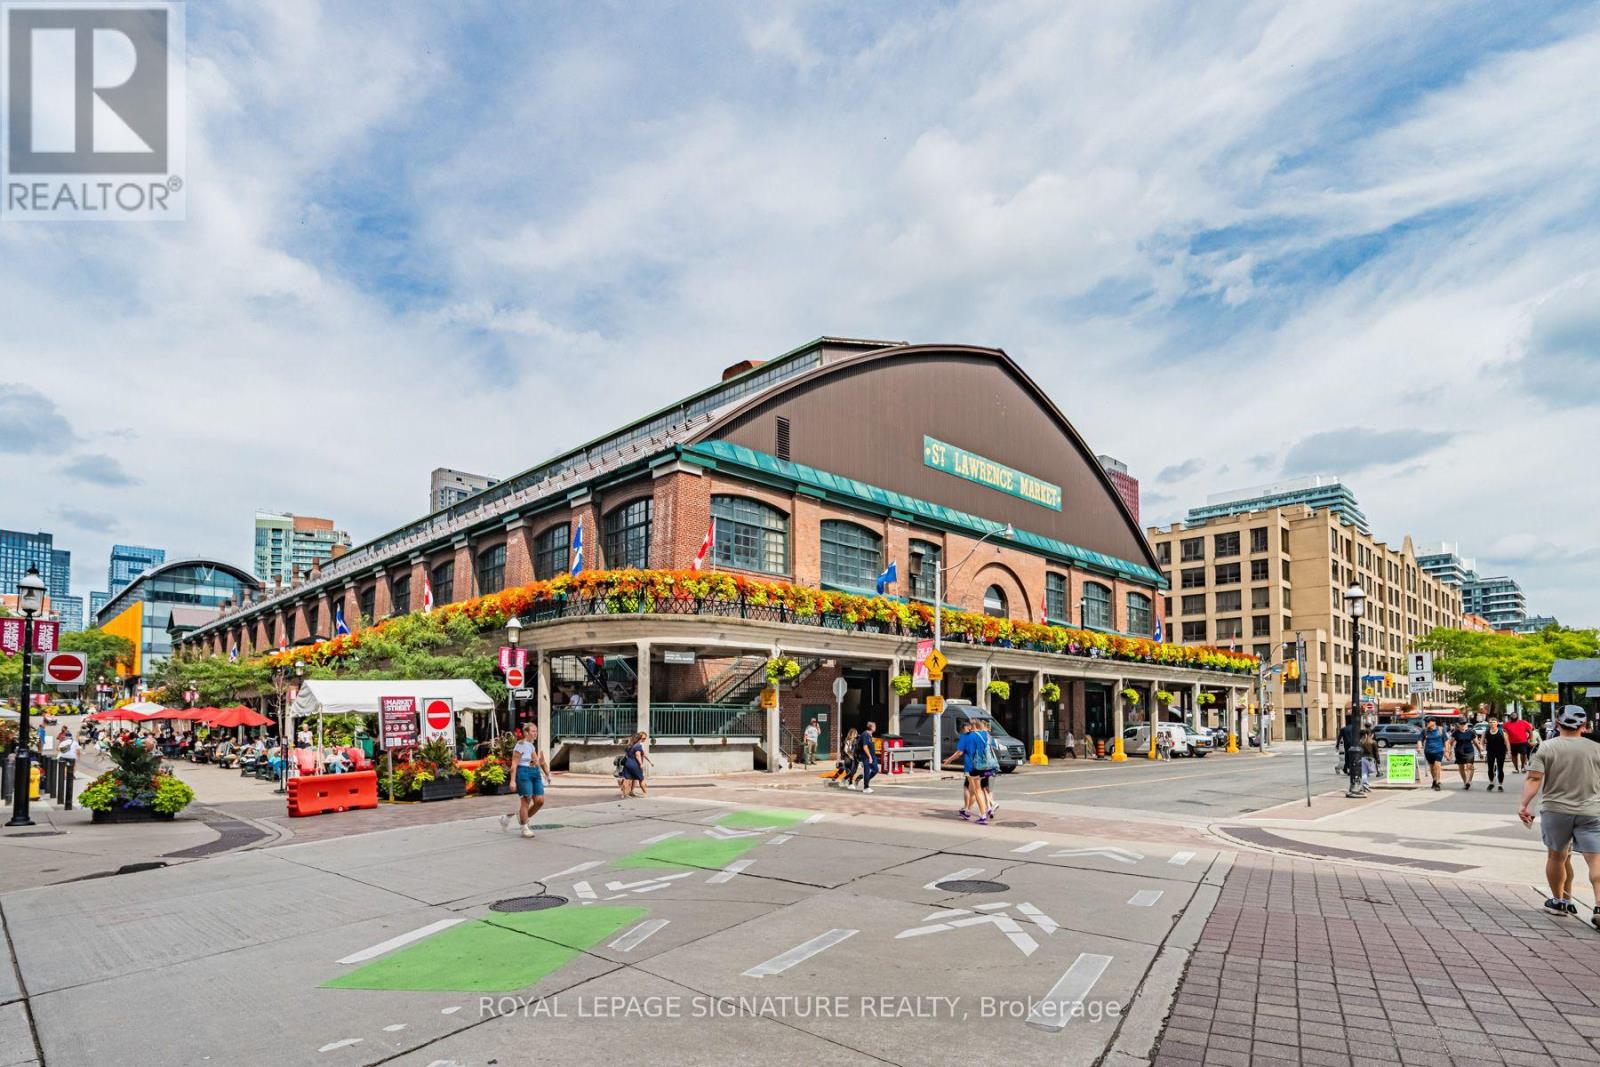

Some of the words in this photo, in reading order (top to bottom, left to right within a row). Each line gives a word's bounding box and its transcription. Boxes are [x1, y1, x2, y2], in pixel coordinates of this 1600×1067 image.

[931, 443, 946, 467] ST
[954, 451, 1014, 491] LAWRENCE
[1020, 475, 1057, 507] MARKET
[3, 621, 11, 649] STREET
[10, 622, 19, 652] MARKET
[38, 624, 47, 651] STREET
